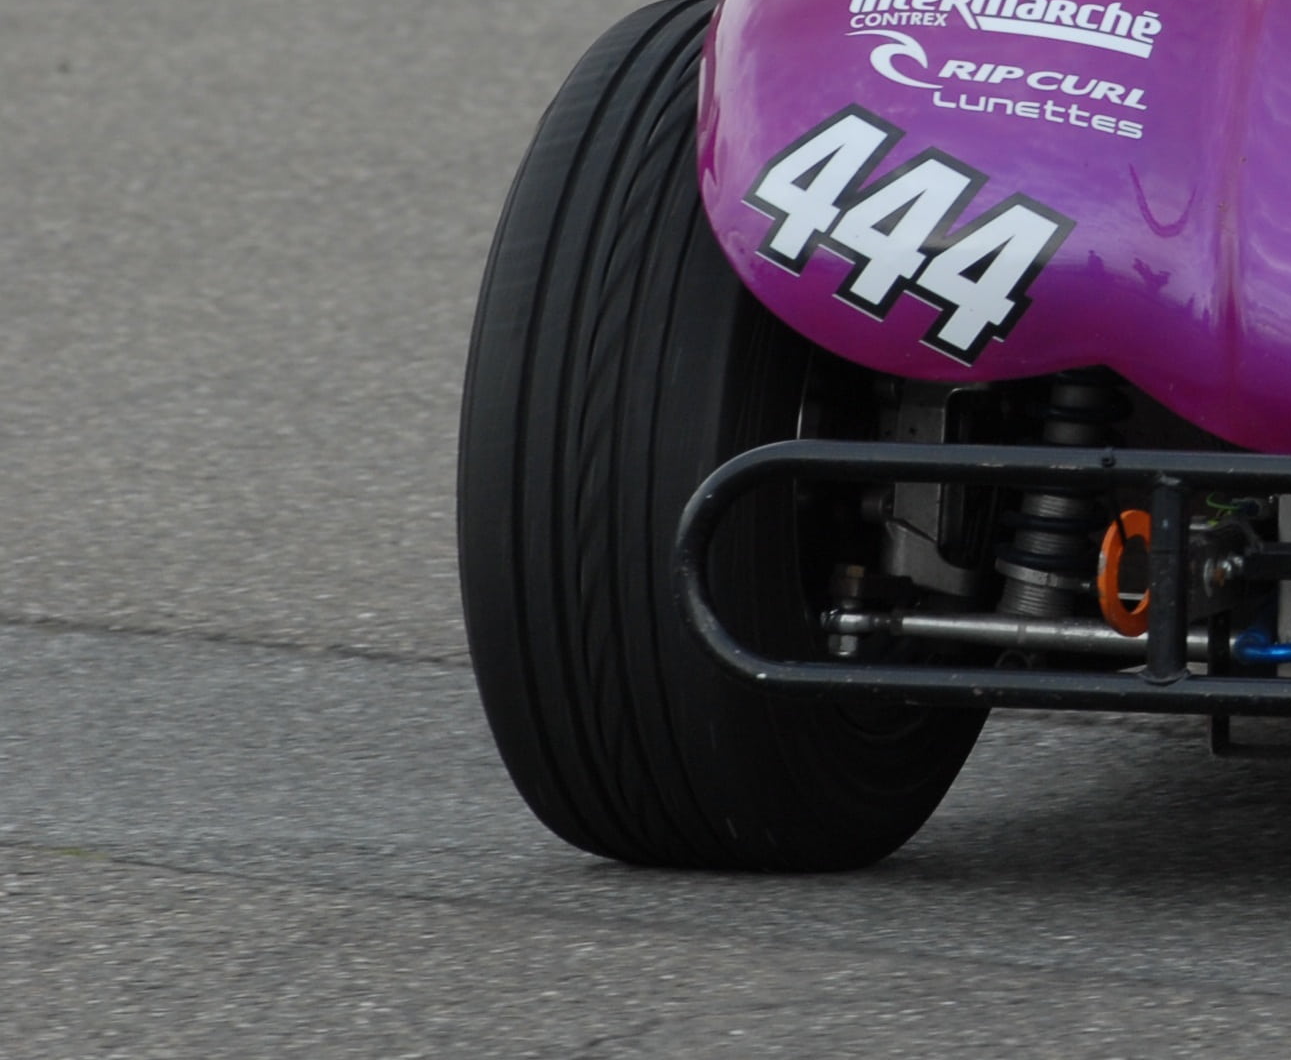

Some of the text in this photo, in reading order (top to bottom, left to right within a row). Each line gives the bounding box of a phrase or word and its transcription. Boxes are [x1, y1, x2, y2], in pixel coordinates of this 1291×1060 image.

[849, 12, 949, 29] CONTREX
[938, 59, 1148, 111] RIP CURL
[932, 90, 1144, 140] Lunettes
[748, 107, 1069, 360] 444
